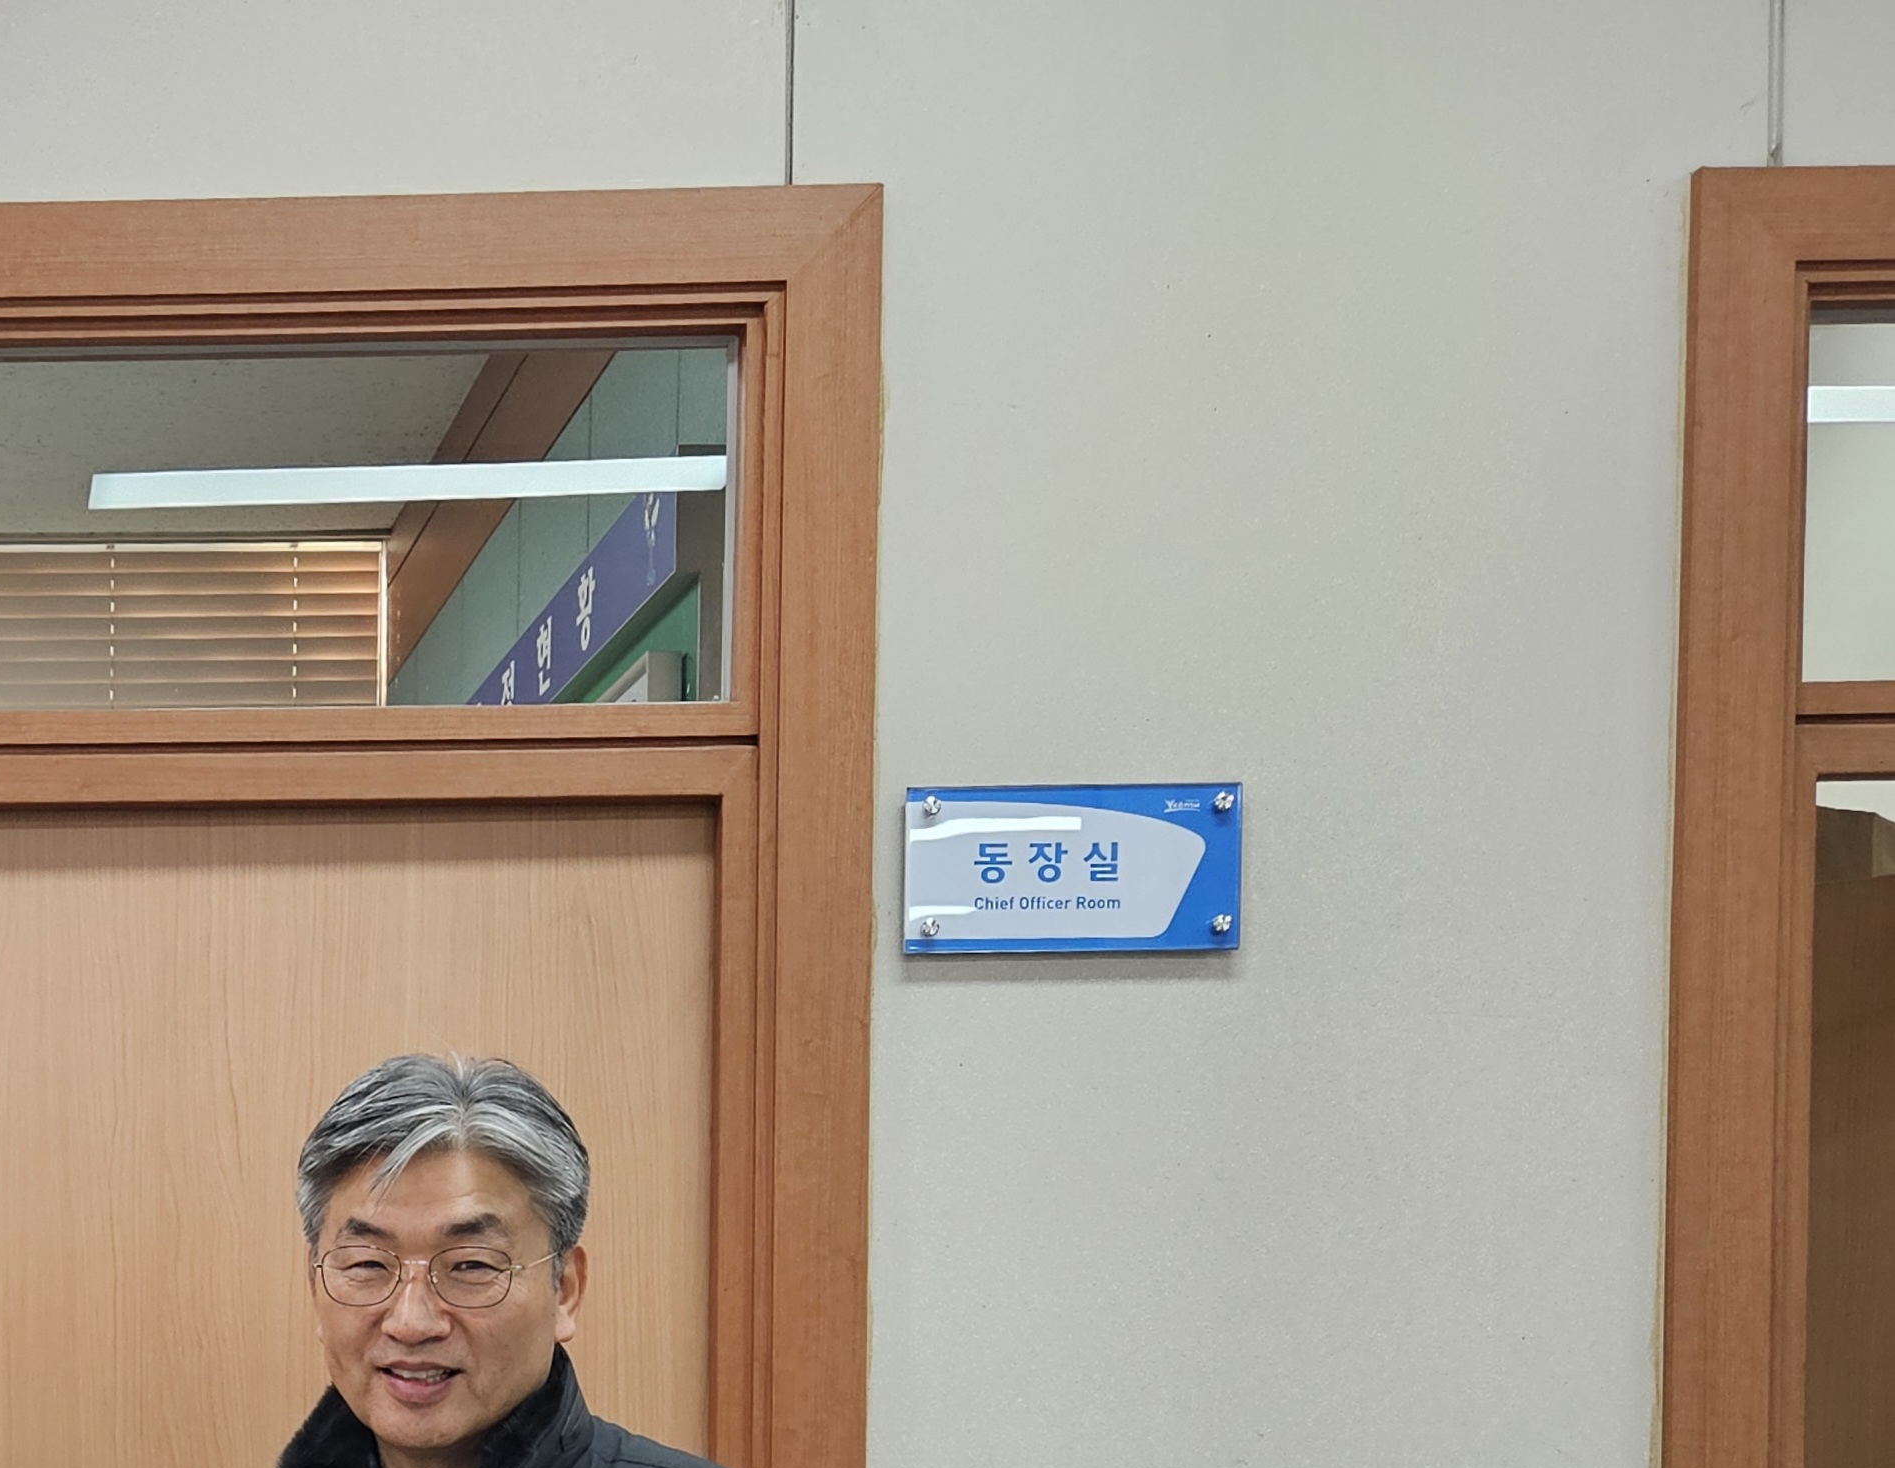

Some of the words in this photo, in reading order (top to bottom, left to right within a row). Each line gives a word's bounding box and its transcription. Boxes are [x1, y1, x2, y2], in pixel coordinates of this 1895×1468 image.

[974, 841, 1119, 883] 동장실
[974, 896, 1015, 910] Chief
[1019, 896, 1071, 910] Officer
[1076, 896, 1121, 910] Room
